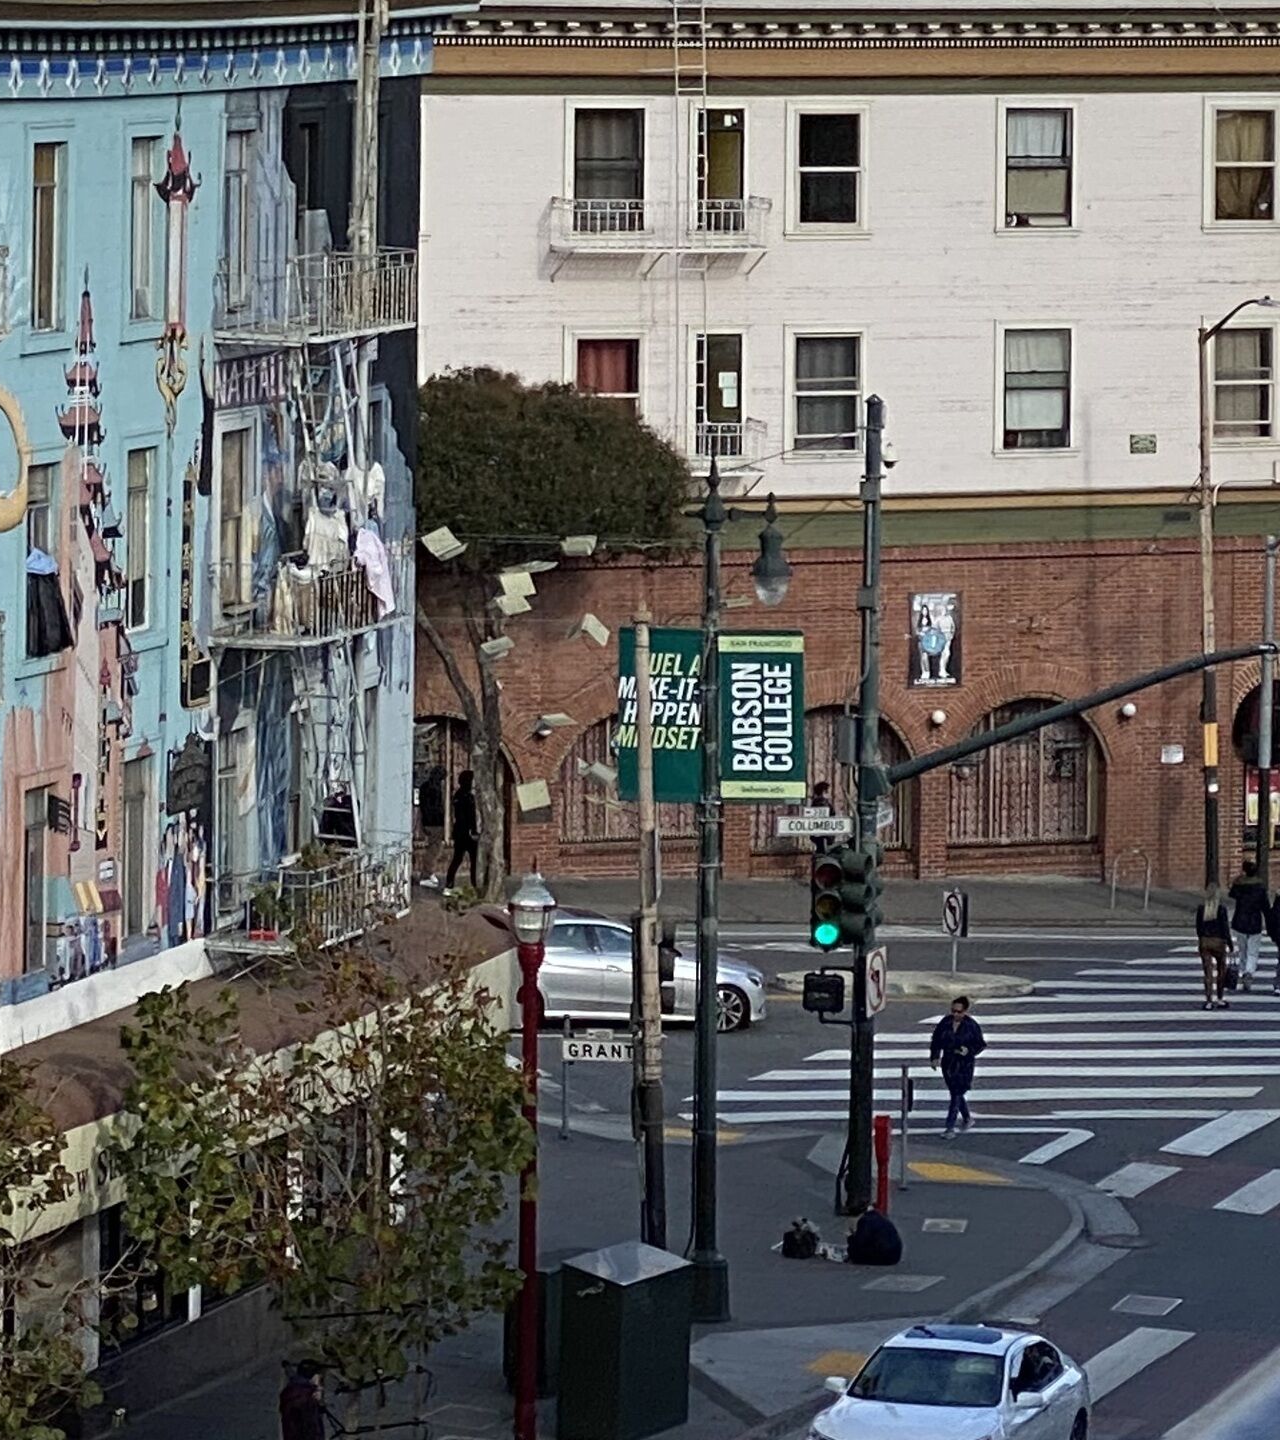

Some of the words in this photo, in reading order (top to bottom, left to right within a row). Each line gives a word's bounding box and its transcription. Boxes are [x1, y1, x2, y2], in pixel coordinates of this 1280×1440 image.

[649, 653, 683, 676] UEL
[688, 655, 702, 676] A
[618, 676, 700, 701] MKE-IT-
[623, 702, 702, 726] HPPEN
[731, 663, 763, 771] BABSON
[763, 663, 793, 771] COLLEGE
[619, 727, 702, 750] MIDSET
[788, 820, 845, 832] COLUMBUS
[568, 1043, 634, 1059] GRANT
